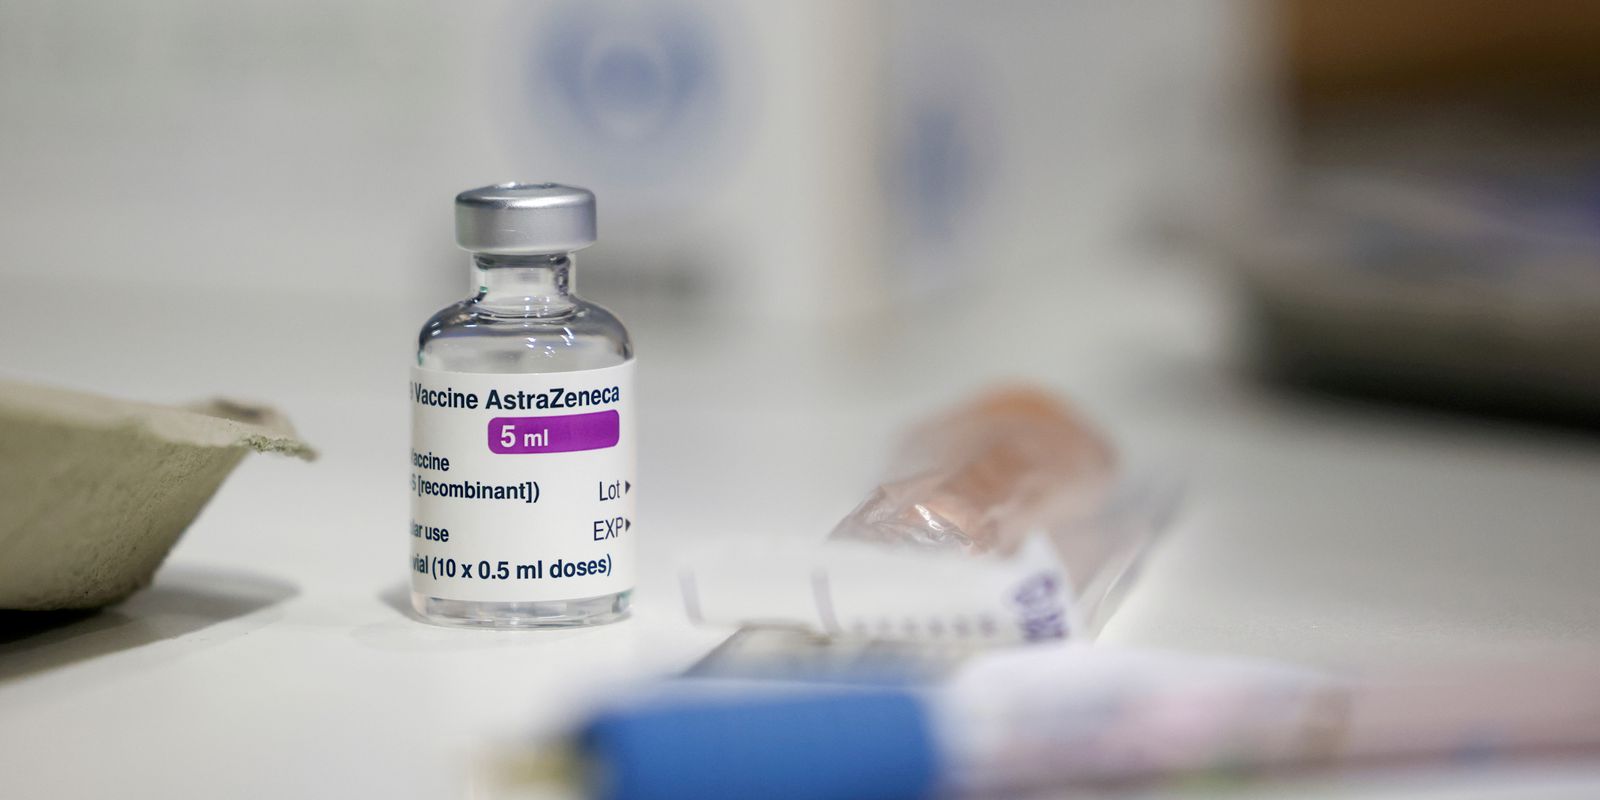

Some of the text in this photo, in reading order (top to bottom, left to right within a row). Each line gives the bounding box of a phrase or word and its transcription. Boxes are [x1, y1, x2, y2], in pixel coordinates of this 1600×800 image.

[414, 382, 478, 409] Vaccine
[485, 386, 620, 410] AstraZeneca
[500, 425, 549, 447] 5 ml
[418, 475, 540, 503] [recombinant])
[599, 480, 620, 501] Lot
[425, 526, 449, 542] use
[593, 517, 624, 541] EXP
[432, 556, 456, 580] (10
[461, 563, 473, 579] x
[478, 561, 510, 579] 0.5
[516, 560, 542, 579] ml
[549, 554, 612, 577] doses)
